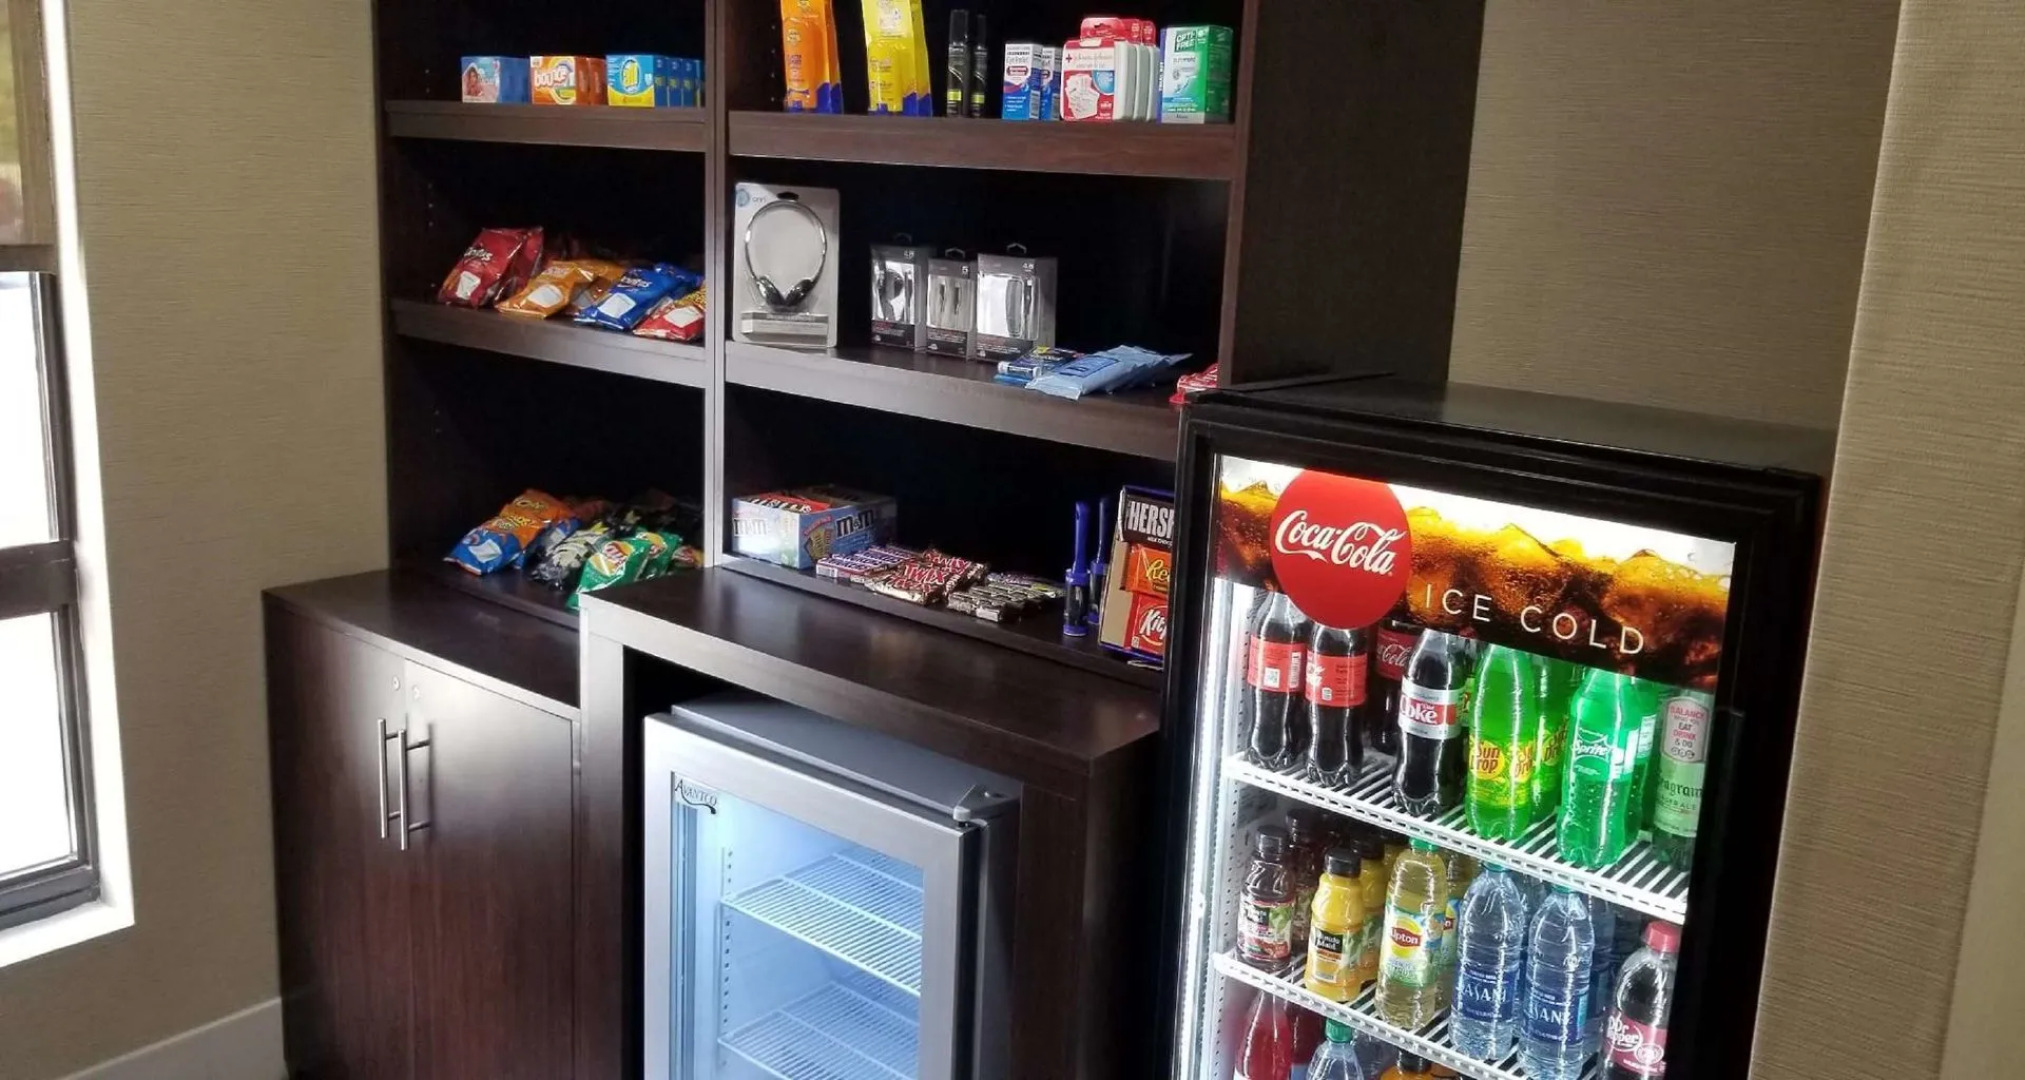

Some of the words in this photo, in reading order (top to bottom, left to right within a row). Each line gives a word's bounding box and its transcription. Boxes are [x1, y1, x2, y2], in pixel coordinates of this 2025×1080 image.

[1274, 509, 1408, 577] Coca-Cola
[904, 561, 950, 585] Twix
[1424, 583, 1492, 622] ICE
[1521, 604, 1646, 656] COLD
[1672, 729, 1697, 741] DRINK
[1678, 722, 1692, 731] EAT
[1574, 739, 1609, 755] Sprite
